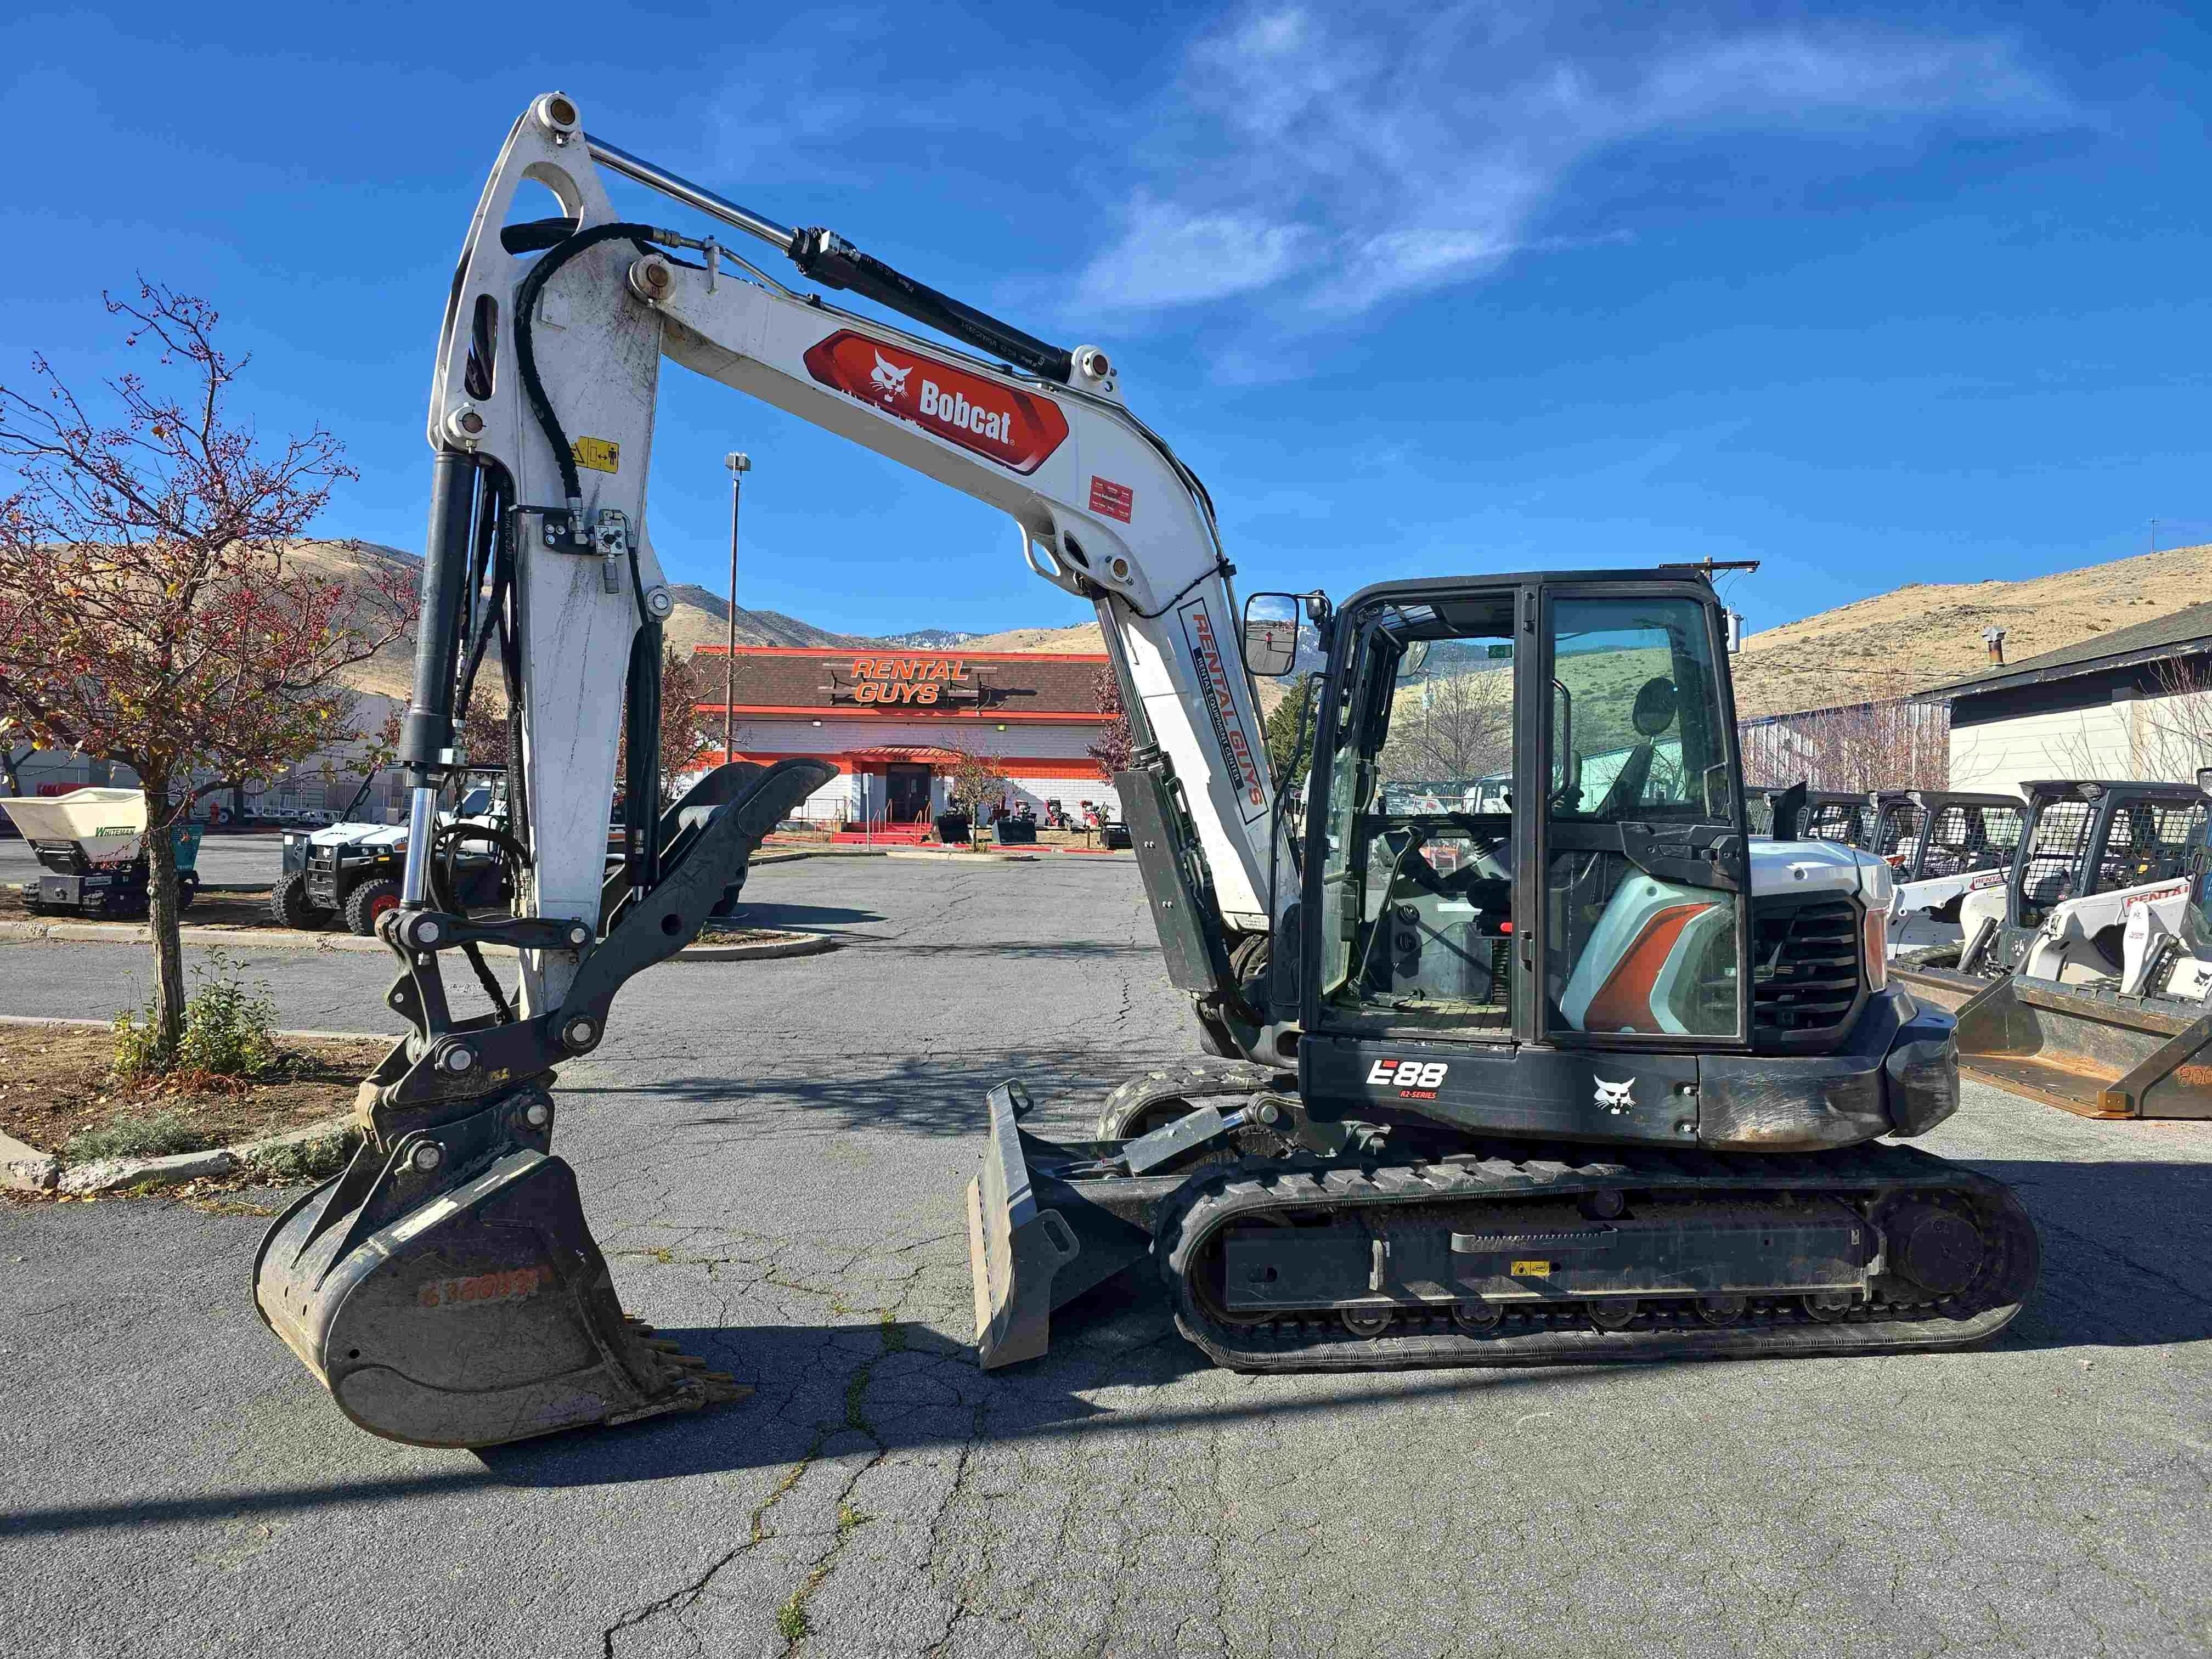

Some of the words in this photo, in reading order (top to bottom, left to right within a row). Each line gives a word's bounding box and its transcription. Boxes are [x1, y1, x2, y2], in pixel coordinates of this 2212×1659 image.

[920, 379, 1011, 444] Bobcat
[851, 658, 969, 681] RENTAL
[855, 682, 939, 704] GUYS
[1193, 614, 1235, 726] RENTAL
[1229, 731, 1263, 805] GUYS
[1198, 658, 1211, 692] RENTAL
[1208, 694, 1228, 744] EQUIPMENT
[1224, 746, 1240, 781] CENTER
[95, 826, 136, 837] WHITEMAN
[1975, 875, 2002, 884] RENTA
[1365, 1059, 1449, 1088] E88
[1400, 1090, 1437, 1099] R2-SERIES
